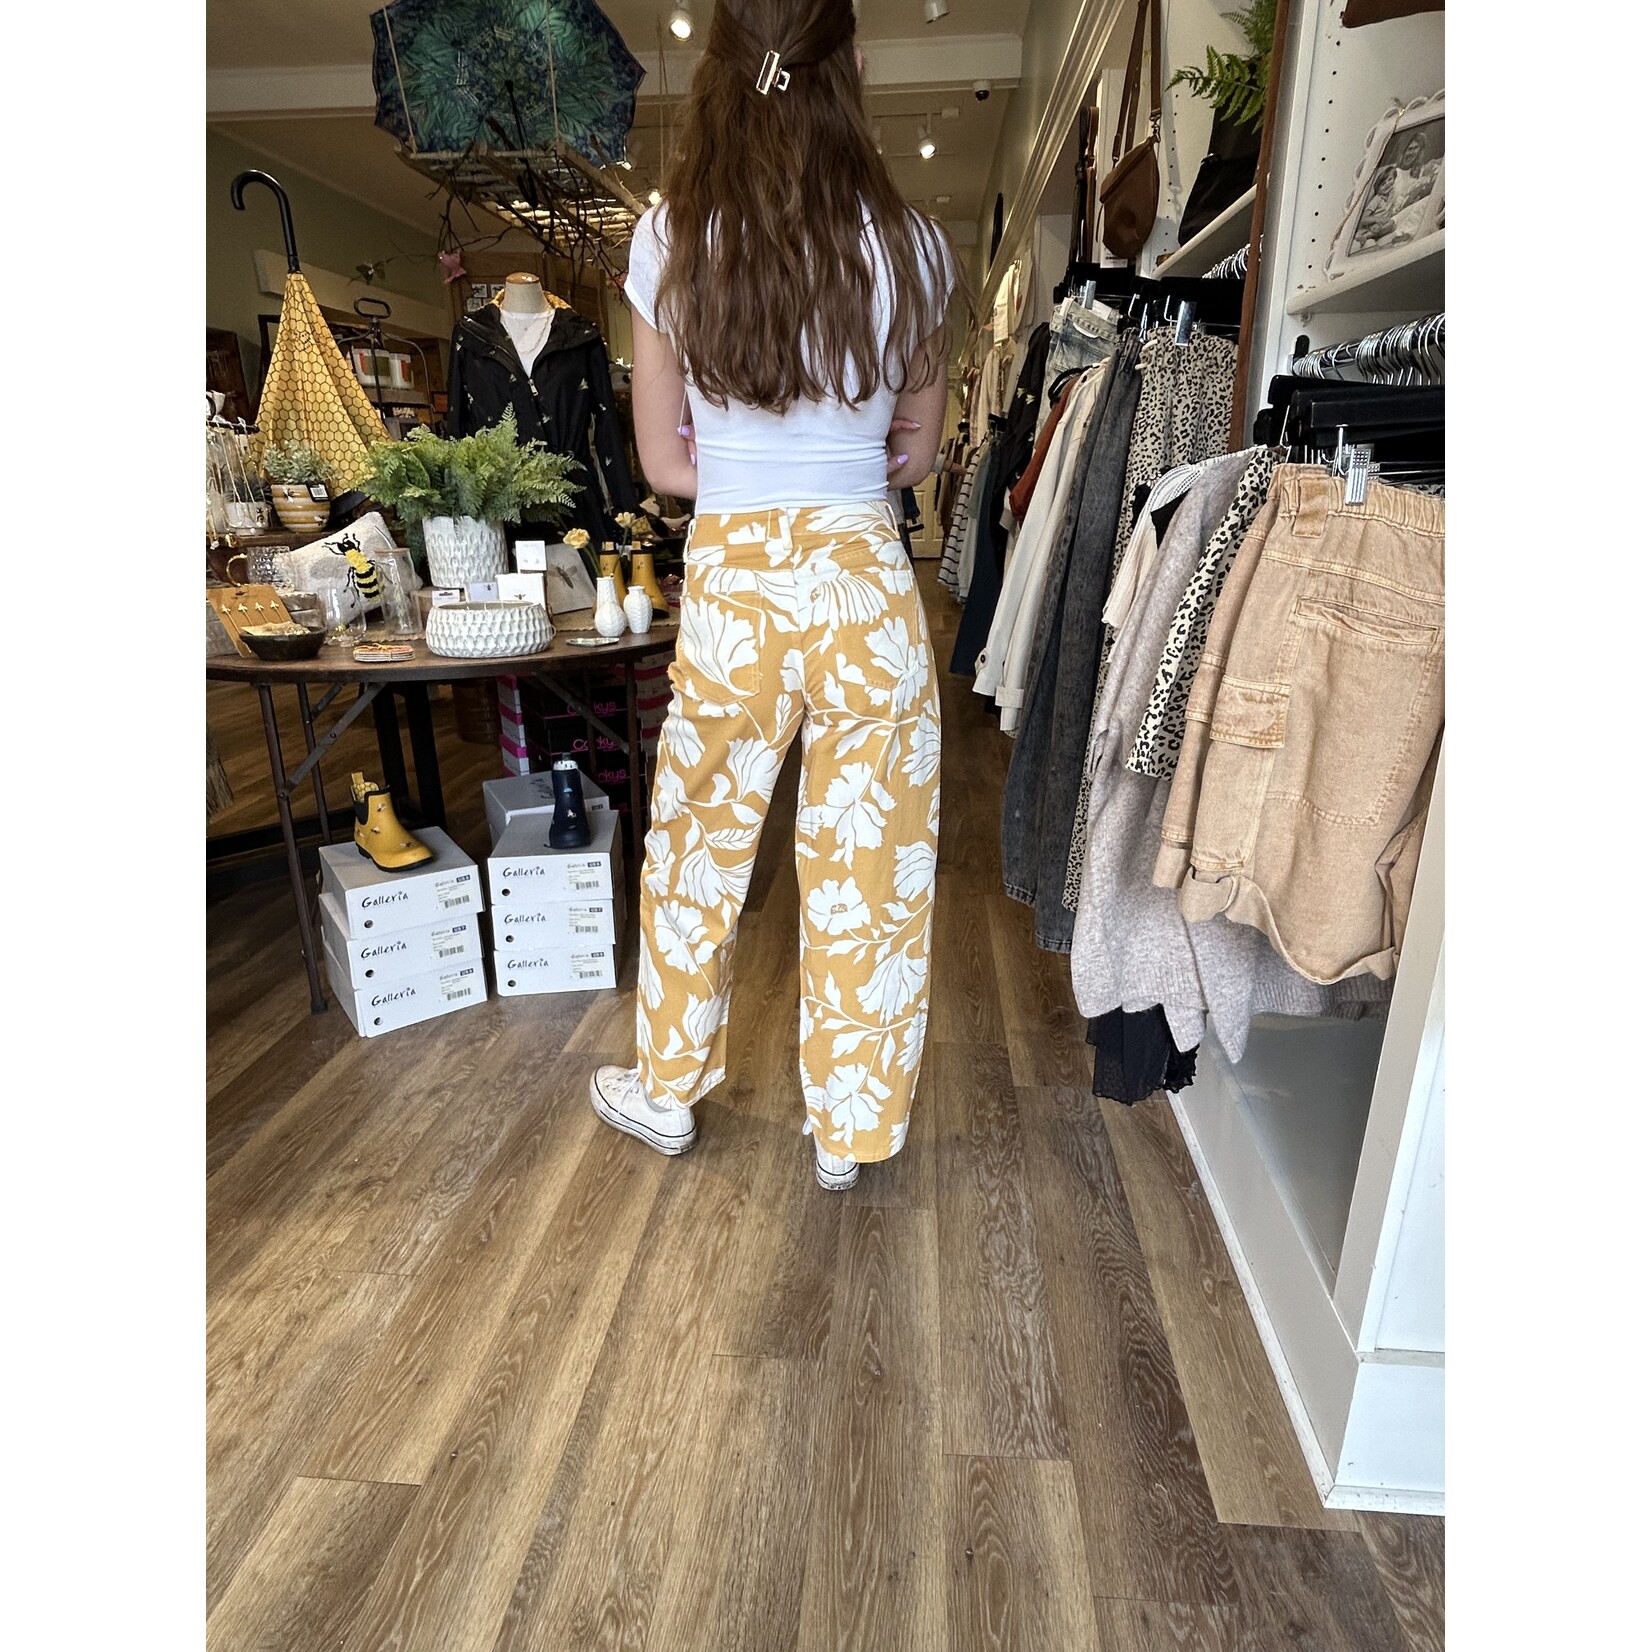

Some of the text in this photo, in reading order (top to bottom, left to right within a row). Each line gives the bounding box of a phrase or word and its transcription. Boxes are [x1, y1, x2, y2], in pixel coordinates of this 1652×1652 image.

[503, 866, 546, 878] Galleria
[361, 890, 409, 909] Galleria
[504, 912, 547, 924] Galleria
[360, 941, 408, 959] Galleria
[507, 958, 550, 969] Galleria
[371, 987, 417, 1007] Galleria
